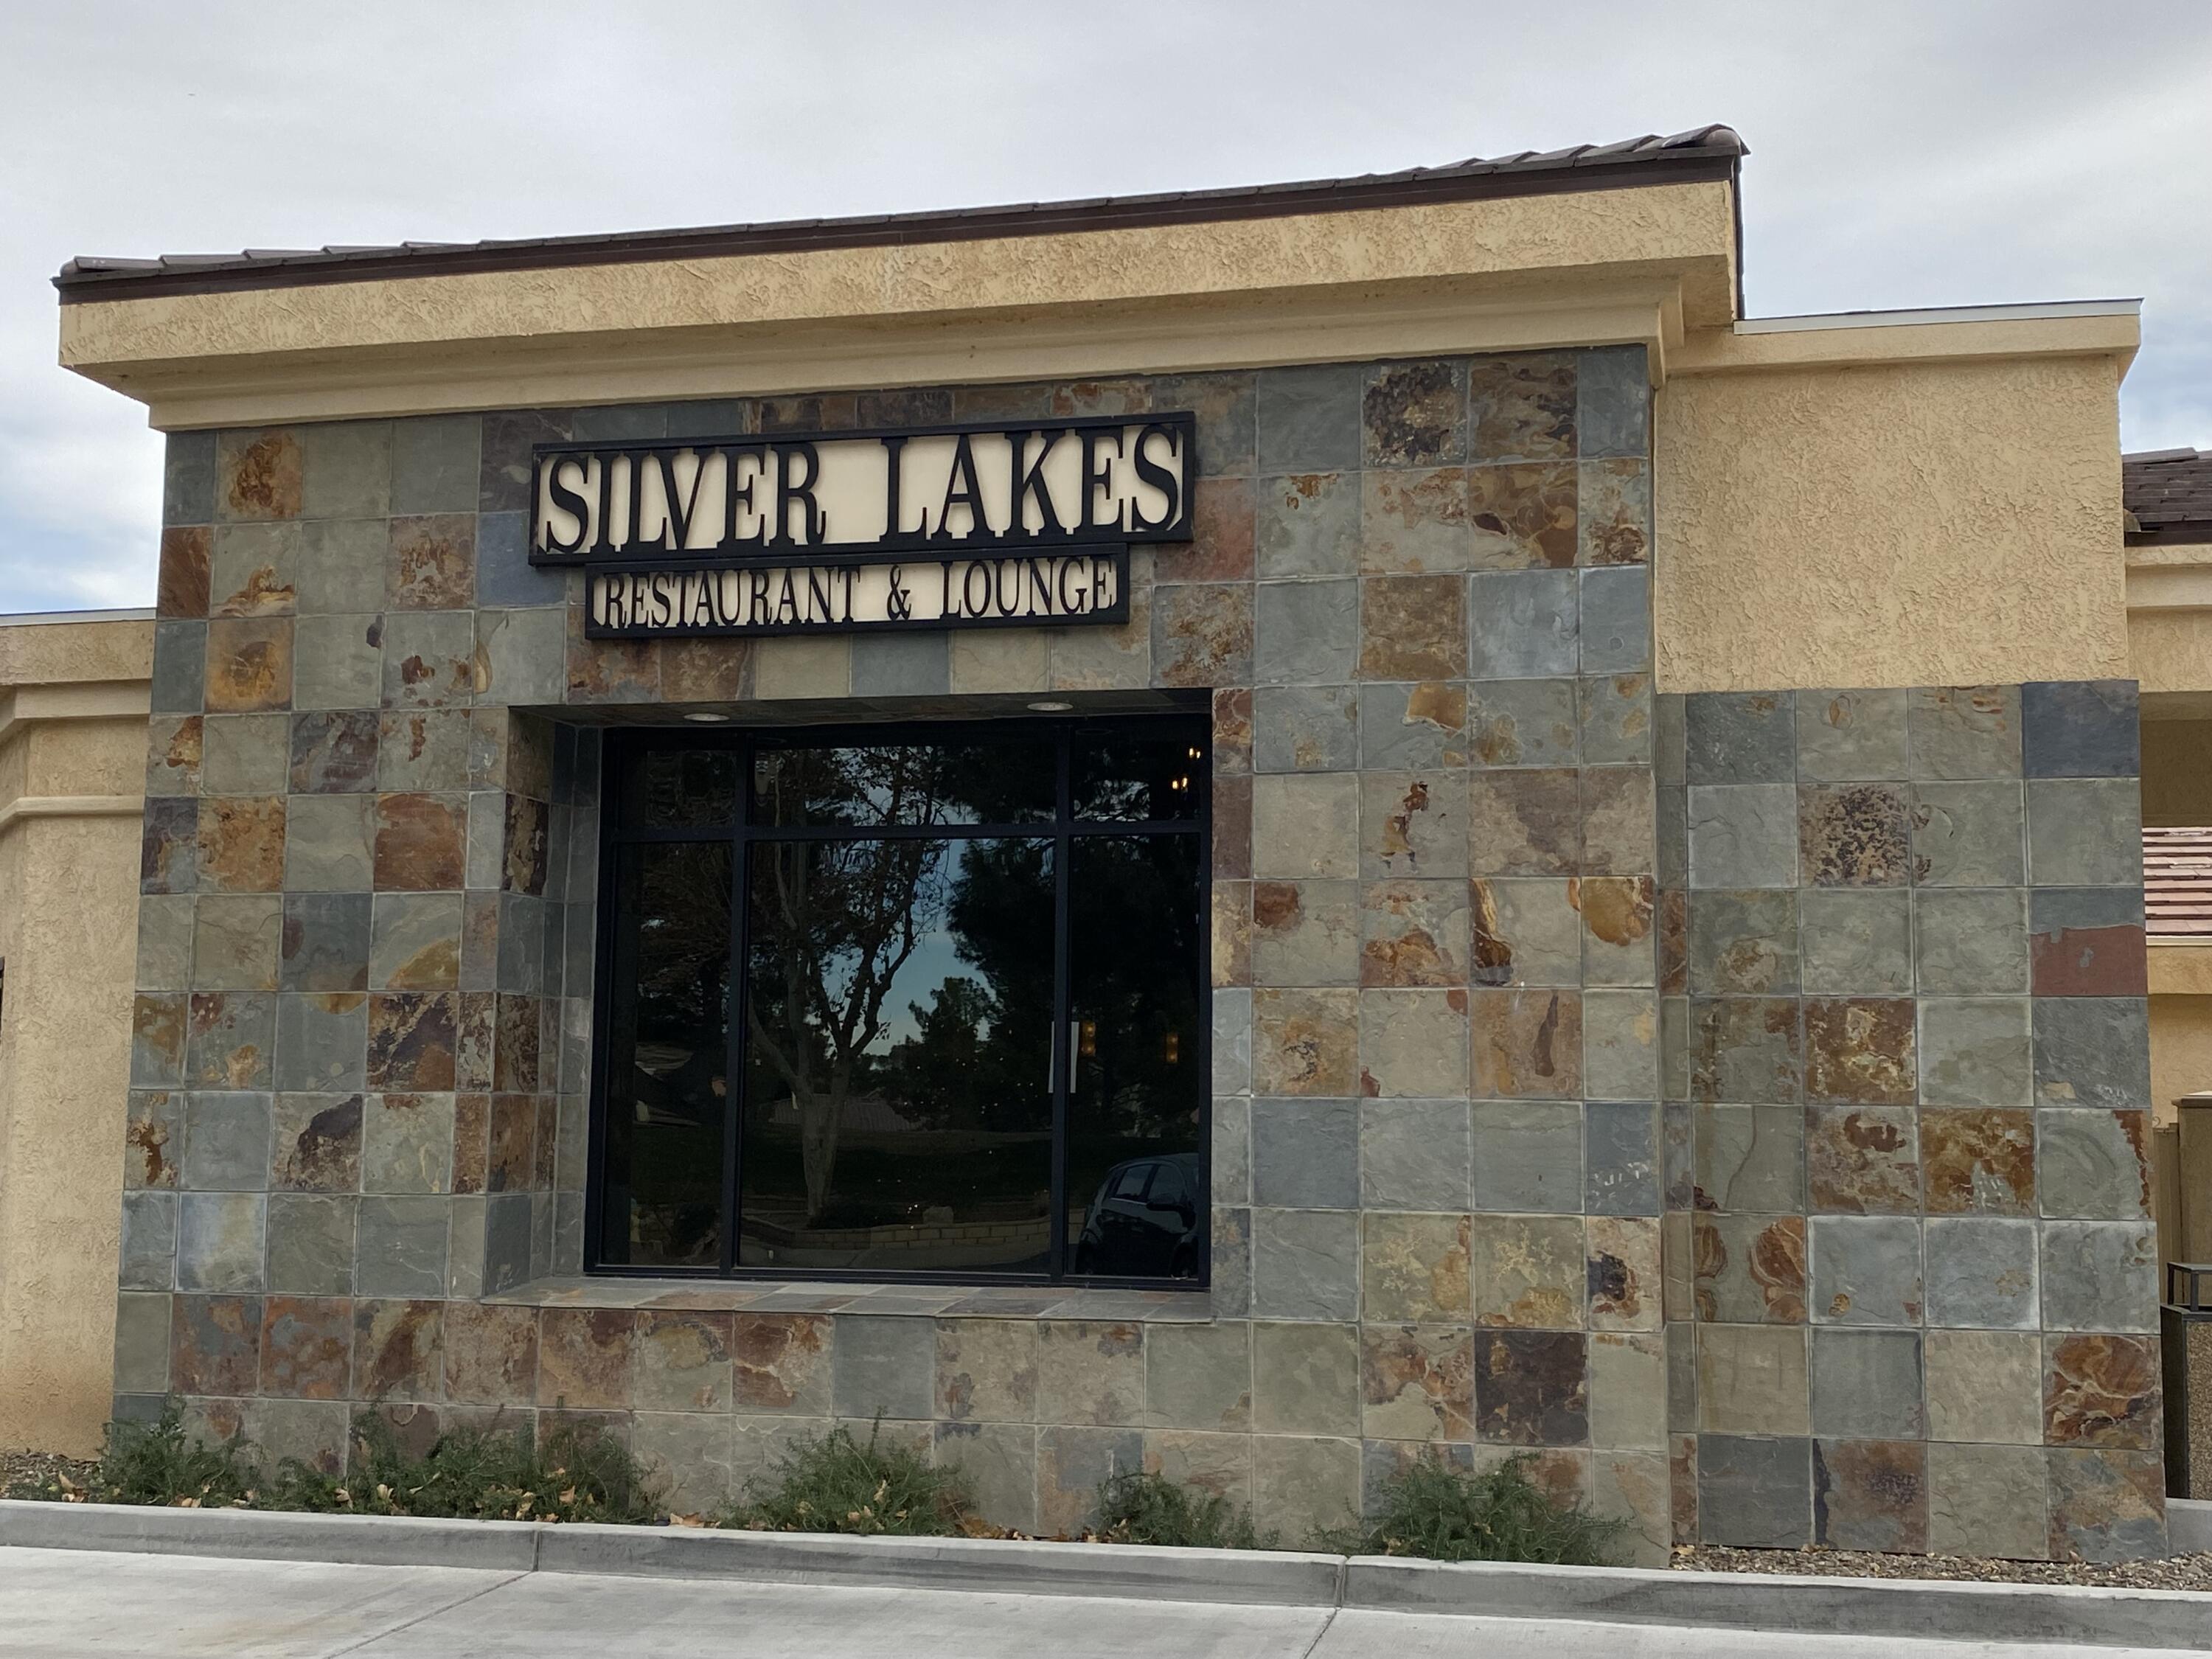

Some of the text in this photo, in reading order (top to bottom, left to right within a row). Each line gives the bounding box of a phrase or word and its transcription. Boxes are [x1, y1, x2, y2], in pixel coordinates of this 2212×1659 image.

[546, 424, 1179, 552] SILVER LAKES
[604, 557, 1113, 628] RESTAURANT & LOUNGE
